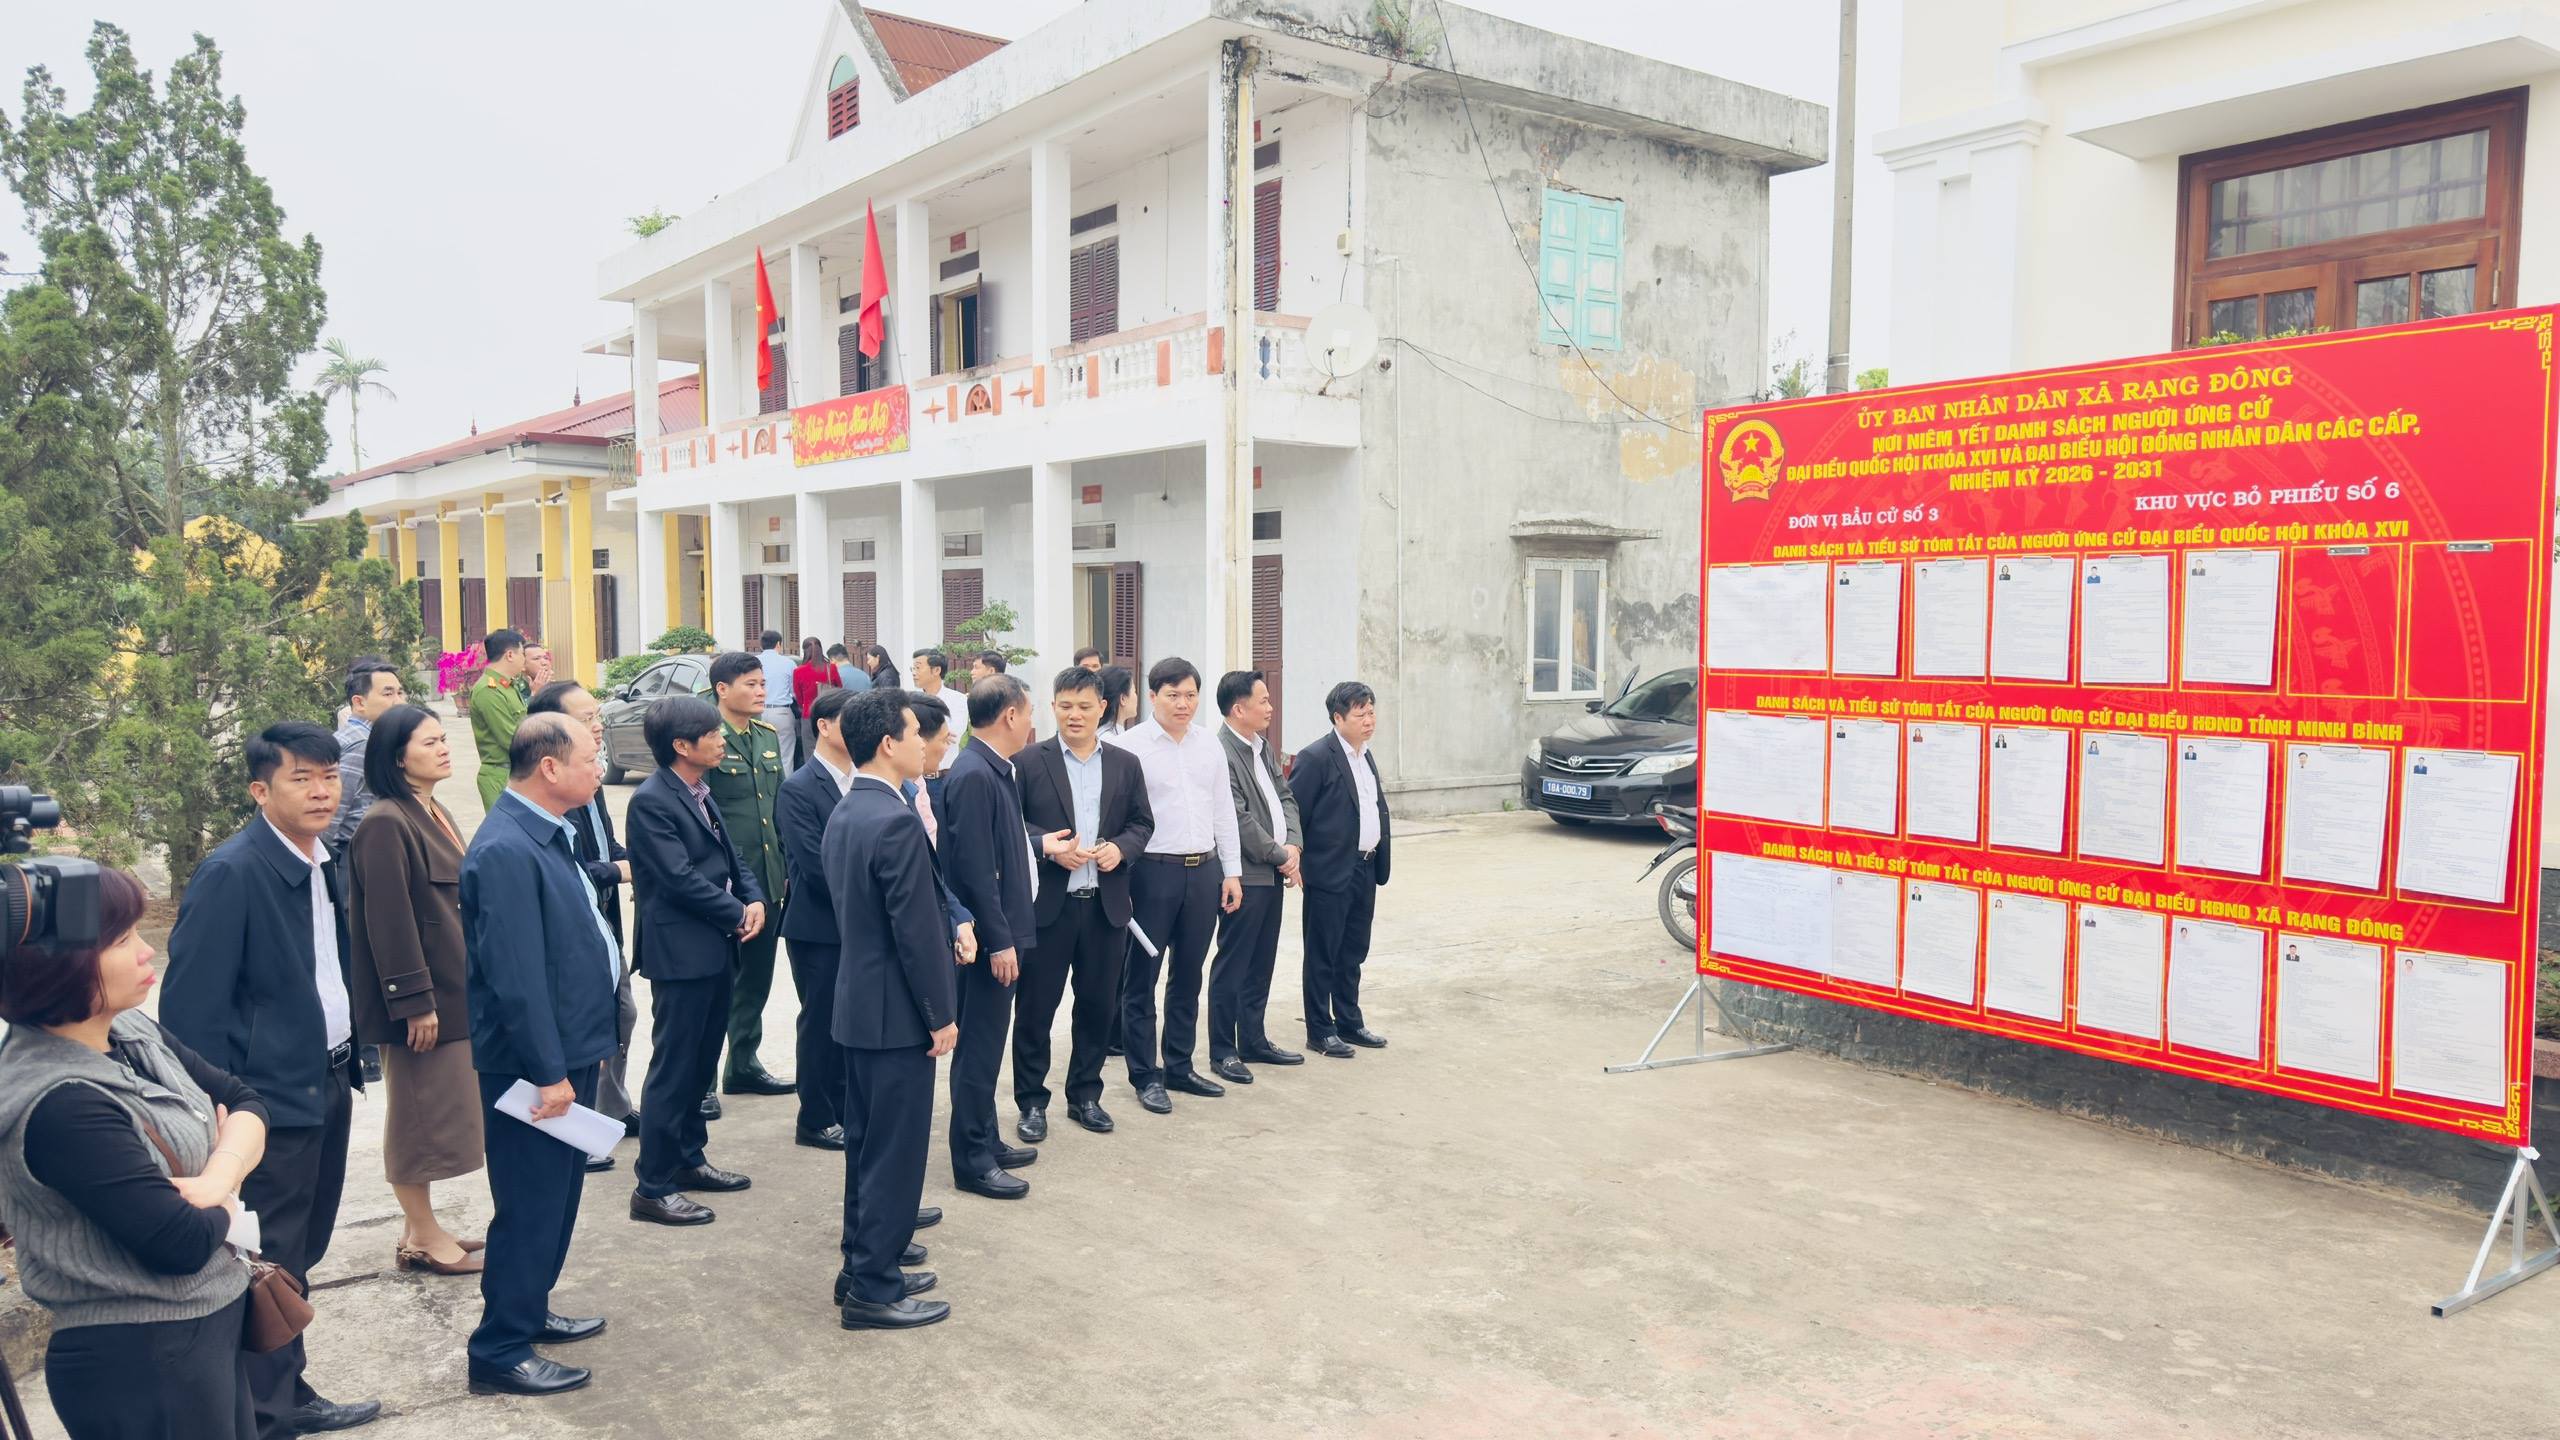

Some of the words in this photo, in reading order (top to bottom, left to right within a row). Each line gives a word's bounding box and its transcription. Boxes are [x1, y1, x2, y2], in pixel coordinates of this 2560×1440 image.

[1858, 407, 1886, 428] ỦY
[1892, 404, 1936, 425] BAN
[1944, 394, 2009, 419] NHÂN
[2016, 387, 2068, 412] DÂN
[2076, 381, 2113, 405] XÃ
[2122, 376, 2200, 403] RẠNG
[2209, 366, 2293, 393] ĐÔNG
[1873, 435, 1902, 453] NƠI
[1907, 429, 1952, 450] NIÊM
[1958, 422, 1990, 445] YẾT
[1995, 421, 2047, 441] DANH
[2053, 415, 2106, 434] SÁCH
[2113, 405, 2178, 428] NGƯỜI
[2185, 404, 2232, 425] ỨNG
[2238, 394, 2272, 419] CỬ
[1787, 465, 1811, 483] ĐẠI
[1813, 457, 1846, 479] BIỂU
[1849, 454, 1890, 477] QUỐC
[1893, 453, 1919, 475] HỘI
[1922, 449, 1967, 470] KHÓA
[1969, 449, 1997, 470] XVI
[2000, 444, 2023, 464] VÀ
[2025, 444, 2056, 467] ĐẠI
[2059, 435, 2102, 459] BIỂU
[2105, 434, 2138, 458] HỘI
[2141, 429, 2197, 453] ĐỒNG
[2201, 425, 2261, 449] NHÂN
[2266, 421, 2312, 445] DÂN
[2316, 416, 2363, 440] CÁC
[1950, 469, 2009, 492] NHIỆM
[2016, 465, 2040, 486] KỲ
[2045, 465, 2093, 483] 2026
[2114, 460, 2162, 479] 2031
[2136, 495, 2177, 510] KHU
[2184, 491, 2226, 510] VỰC
[2233, 485, 2262, 506] BỎ
[2270, 480, 2339, 504] PHIẾU
[2347, 477, 2378, 500] SỐ
[2385, 482, 2399, 498] 6
[1789, 514, 1818, 528] ĐƠN
[1822, 514, 1837, 528] VỊ
[1842, 507, 1872, 526] BẦU
[1877, 506, 1898, 524] CỬ
[1903, 504, 1924, 522] SỐ
[1929, 508, 1938, 521] 3
[1774, 545, 1808, 557] DANH
[1810, 542, 1844, 556] SÁCH
[1847, 540, 1864, 555] VÀ
[1923, 537, 1953, 552] TÓM
[1987, 532, 2017, 550] CỦA
[2140, 530, 2168, 547] ĐẠI
[2220, 522, 2270, 543] QUỐC
[2276, 522, 2308, 544] HỘI
[2315, 520, 2368, 539] KHÓA
[2375, 521, 2408, 537] XVI
[1757, 696, 1789, 709] DANH
[1792, 696, 1825, 710] SÁCH
[1829, 697, 1845, 711] VÀ
[1903, 701, 1932, 716] TÓM
[1966, 702, 1995, 719] CỦA
[2115, 712, 2143, 730] ĐẠI
[2193, 716, 2242, 732] HĐND
[2248, 715, 2291, 735] TỈNH
[2298, 721, 2346, 738] NINH
[2353, 721, 2402, 740] BÌNH
[1763, 843, 1796, 858] DANH
[1800, 847, 1832, 863] SÁCH
[1836, 851, 1852, 865] VÀ
[1910, 861, 1940, 877] TÓM
[1973, 868, 2002, 885] CỦA
[2123, 889, 2150, 908] ĐẠI
[2201, 900, 2250, 919] HĐND
[2256, 906, 2281, 923] XÃ
[2287, 911, 2340, 932] RẠNG
[2347, 918, 2403, 940] ĐÔNG
